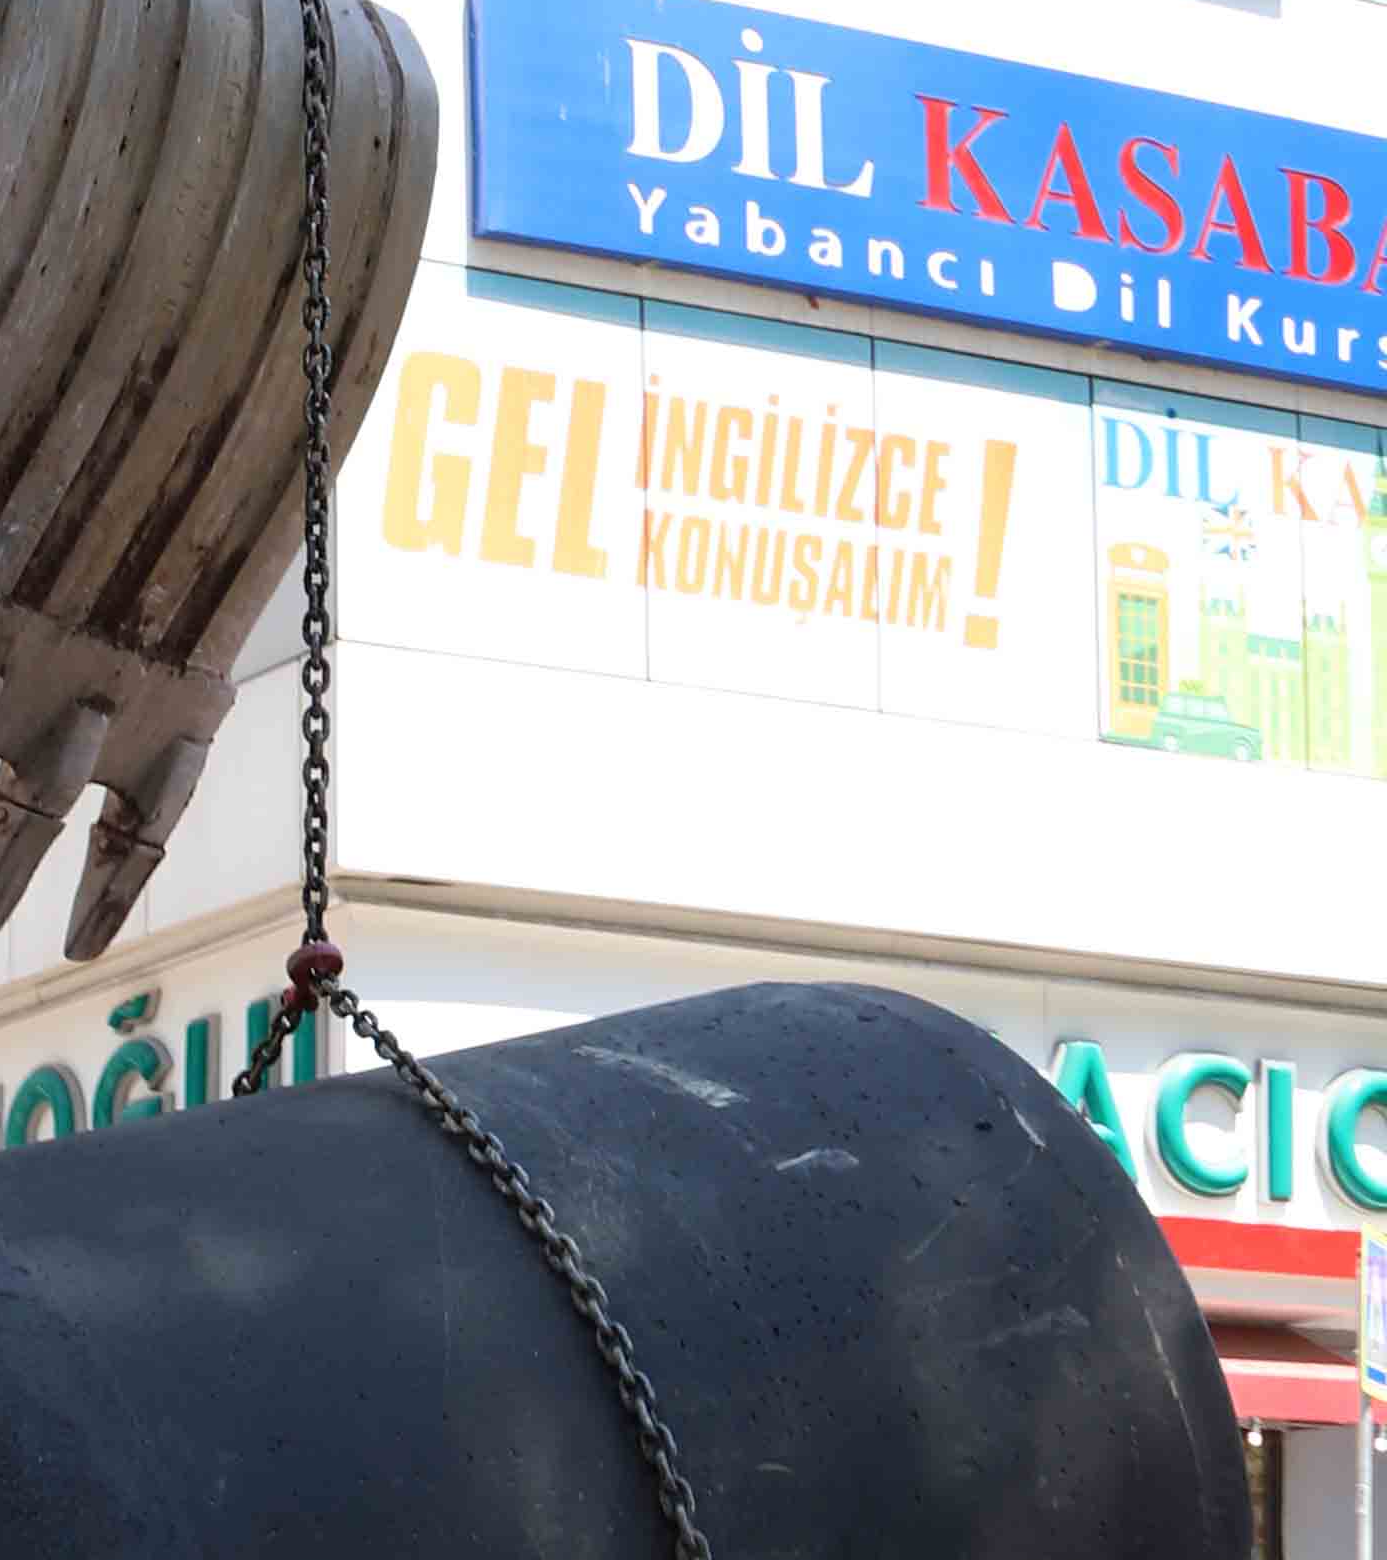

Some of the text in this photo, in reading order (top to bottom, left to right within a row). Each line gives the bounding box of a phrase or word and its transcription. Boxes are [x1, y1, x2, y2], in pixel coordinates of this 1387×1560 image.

[625, 26, 1387, 297] DİL KASAB
[626, 181, 995, 297] Yabancı
[1051, 260, 1175, 331] Dil
[378, 349, 614, 579] GEL
[634, 372, 951, 538] İNGİLİZCE
[1101, 407, 1240, 512] DİL
[634, 506, 953, 632] KONUŞALIM
